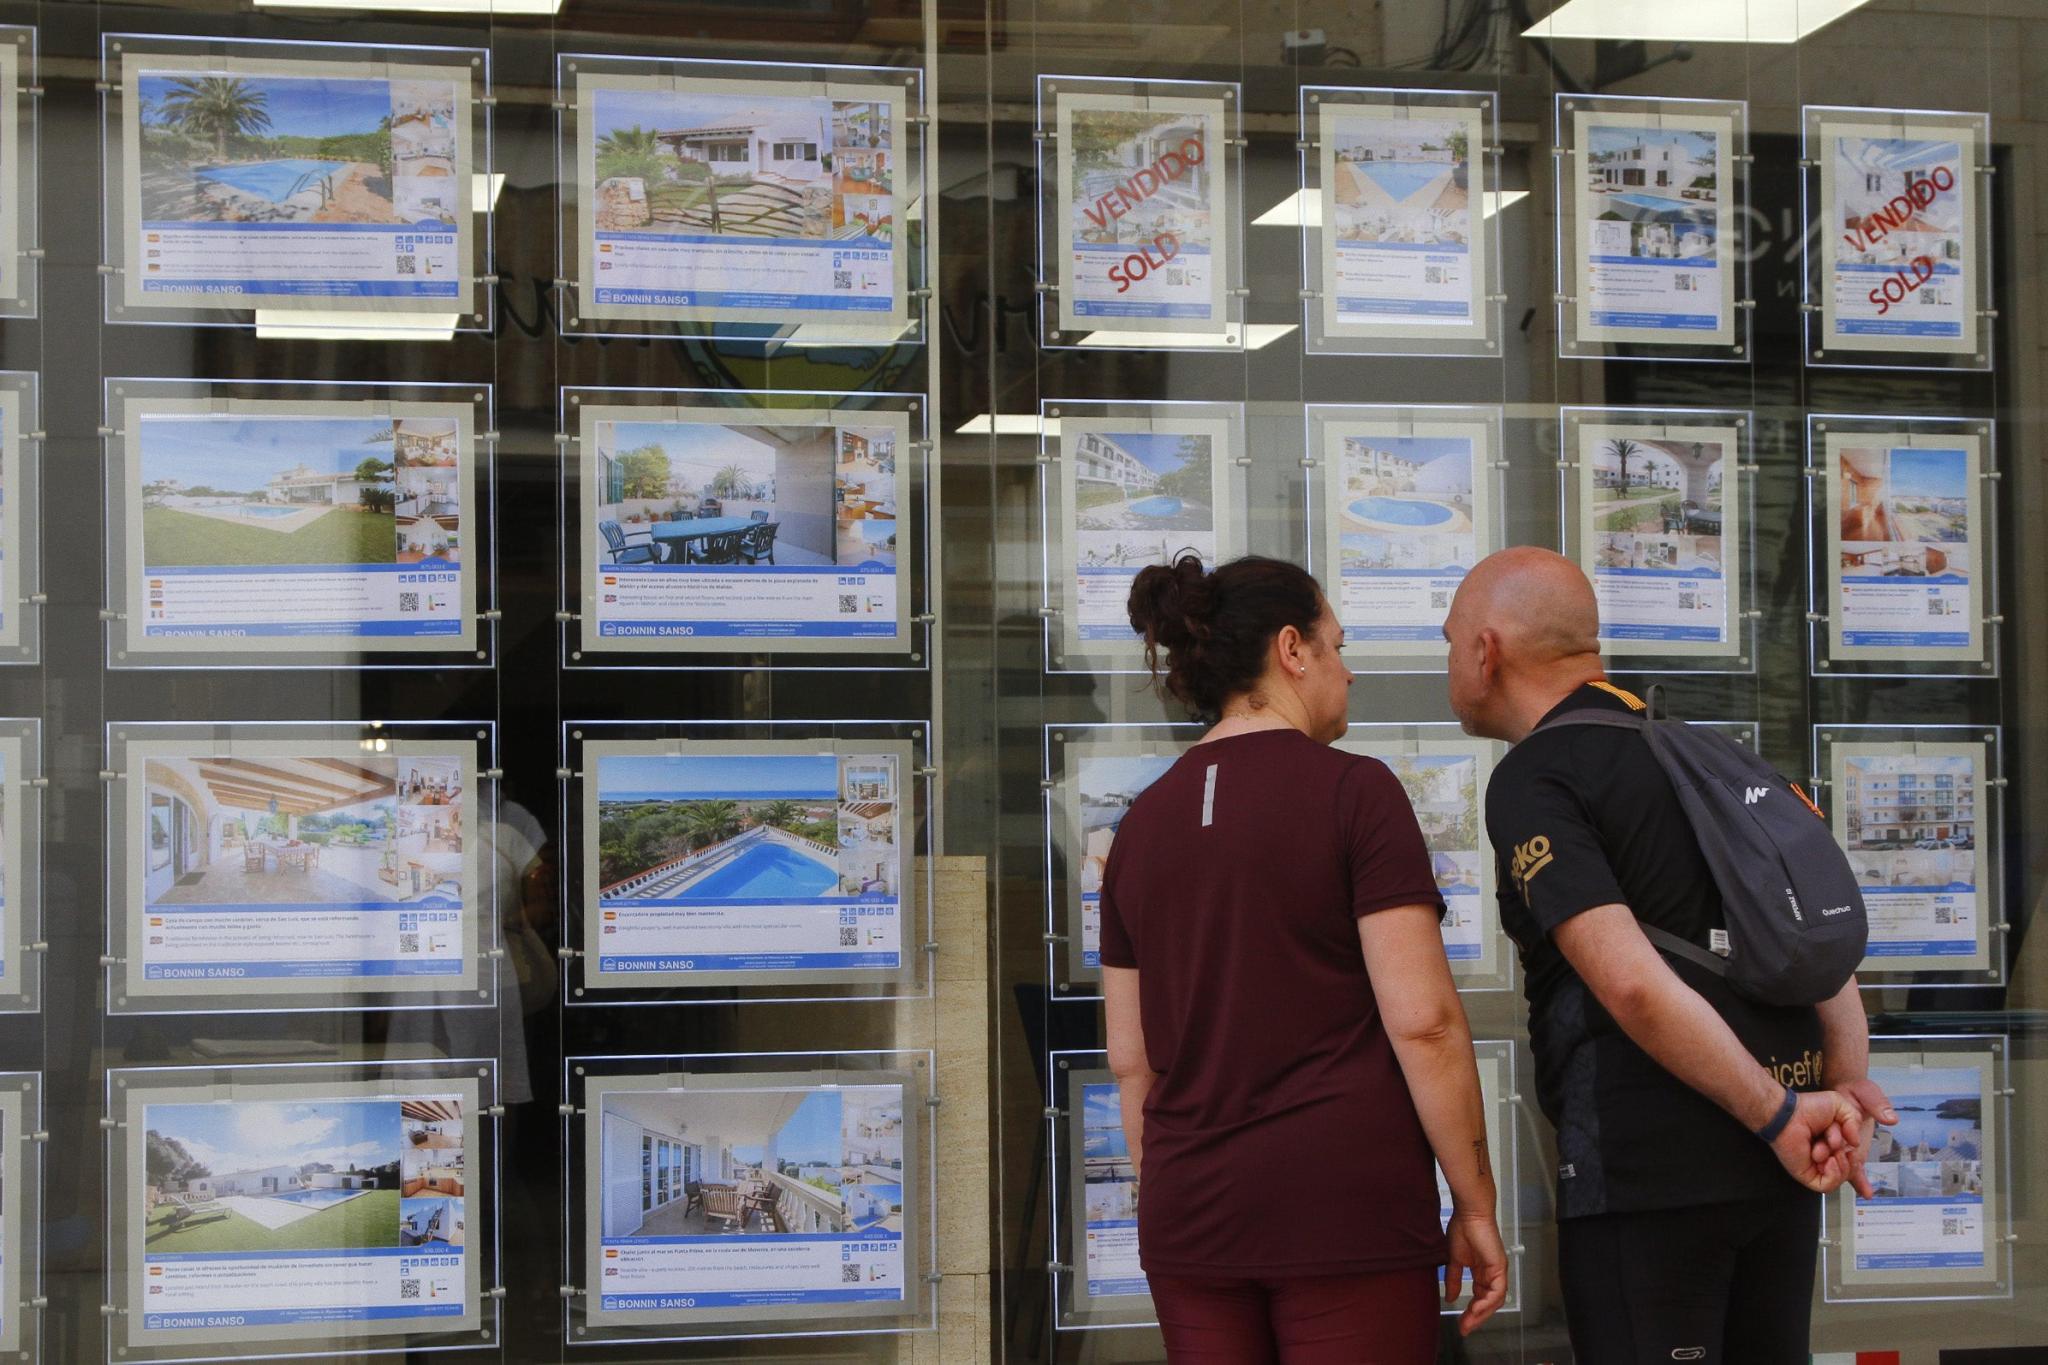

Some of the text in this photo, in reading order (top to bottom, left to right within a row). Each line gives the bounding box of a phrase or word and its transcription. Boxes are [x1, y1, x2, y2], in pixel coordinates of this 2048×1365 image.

[1083, 139, 1205, 229] VENDIDO
[1844, 166, 1955, 252] VENDIDO
[1108, 232, 1182, 293] SOLD
[162, 285, 243, 294] BONNIN SANSO
[1869, 255, 1934, 315] SOLD
[612, 294, 689, 305] BONNIN SANSO
[617, 626, 694, 635] BONNIN SANSO
[1822, 905, 1851, 916] Quechua
[617, 960, 694, 970] BONNIN SANSO
[163, 967, 245, 978] BONNIN SANSO
[618, 1298, 695, 1309] BONNIN SANSO
[163, 1316, 245, 1328] BONNIN SANSO
